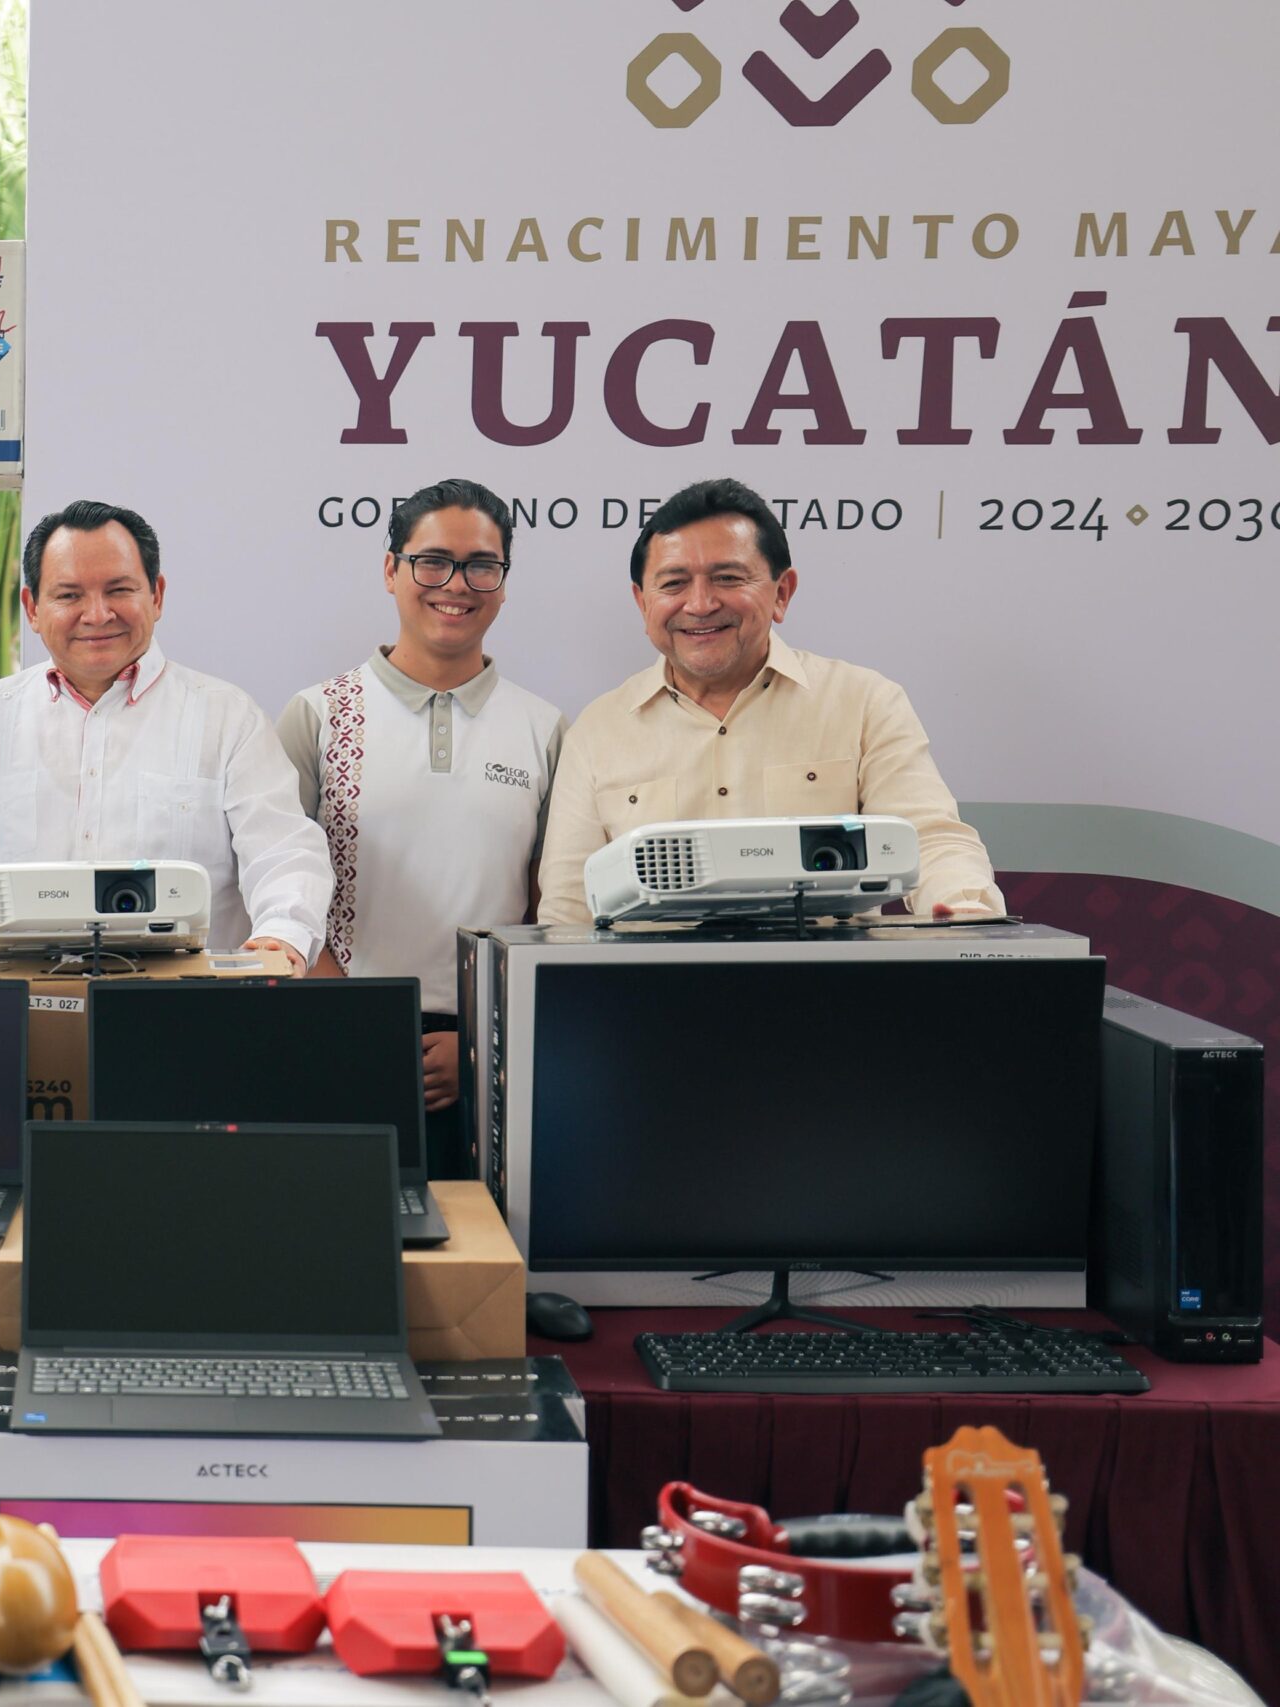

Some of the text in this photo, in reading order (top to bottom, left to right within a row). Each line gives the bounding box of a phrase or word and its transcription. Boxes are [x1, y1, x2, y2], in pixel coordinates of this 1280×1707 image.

[324, 209, 1280, 262] RENACIMIENTO MAY
[315, 291, 1280, 447] YUCATÁN
[319, 497, 578, 529] GONO
[772, 498, 903, 531] TADO
[979, 498, 1109, 541] 2024
[485, 772, 531, 789] NACIONAL
[740, 847, 774, 858] EPSON
[38, 891, 69, 899] EPSON
[59, 999, 79, 1010] 027
[197, 1463, 268, 1479] ACTECK
